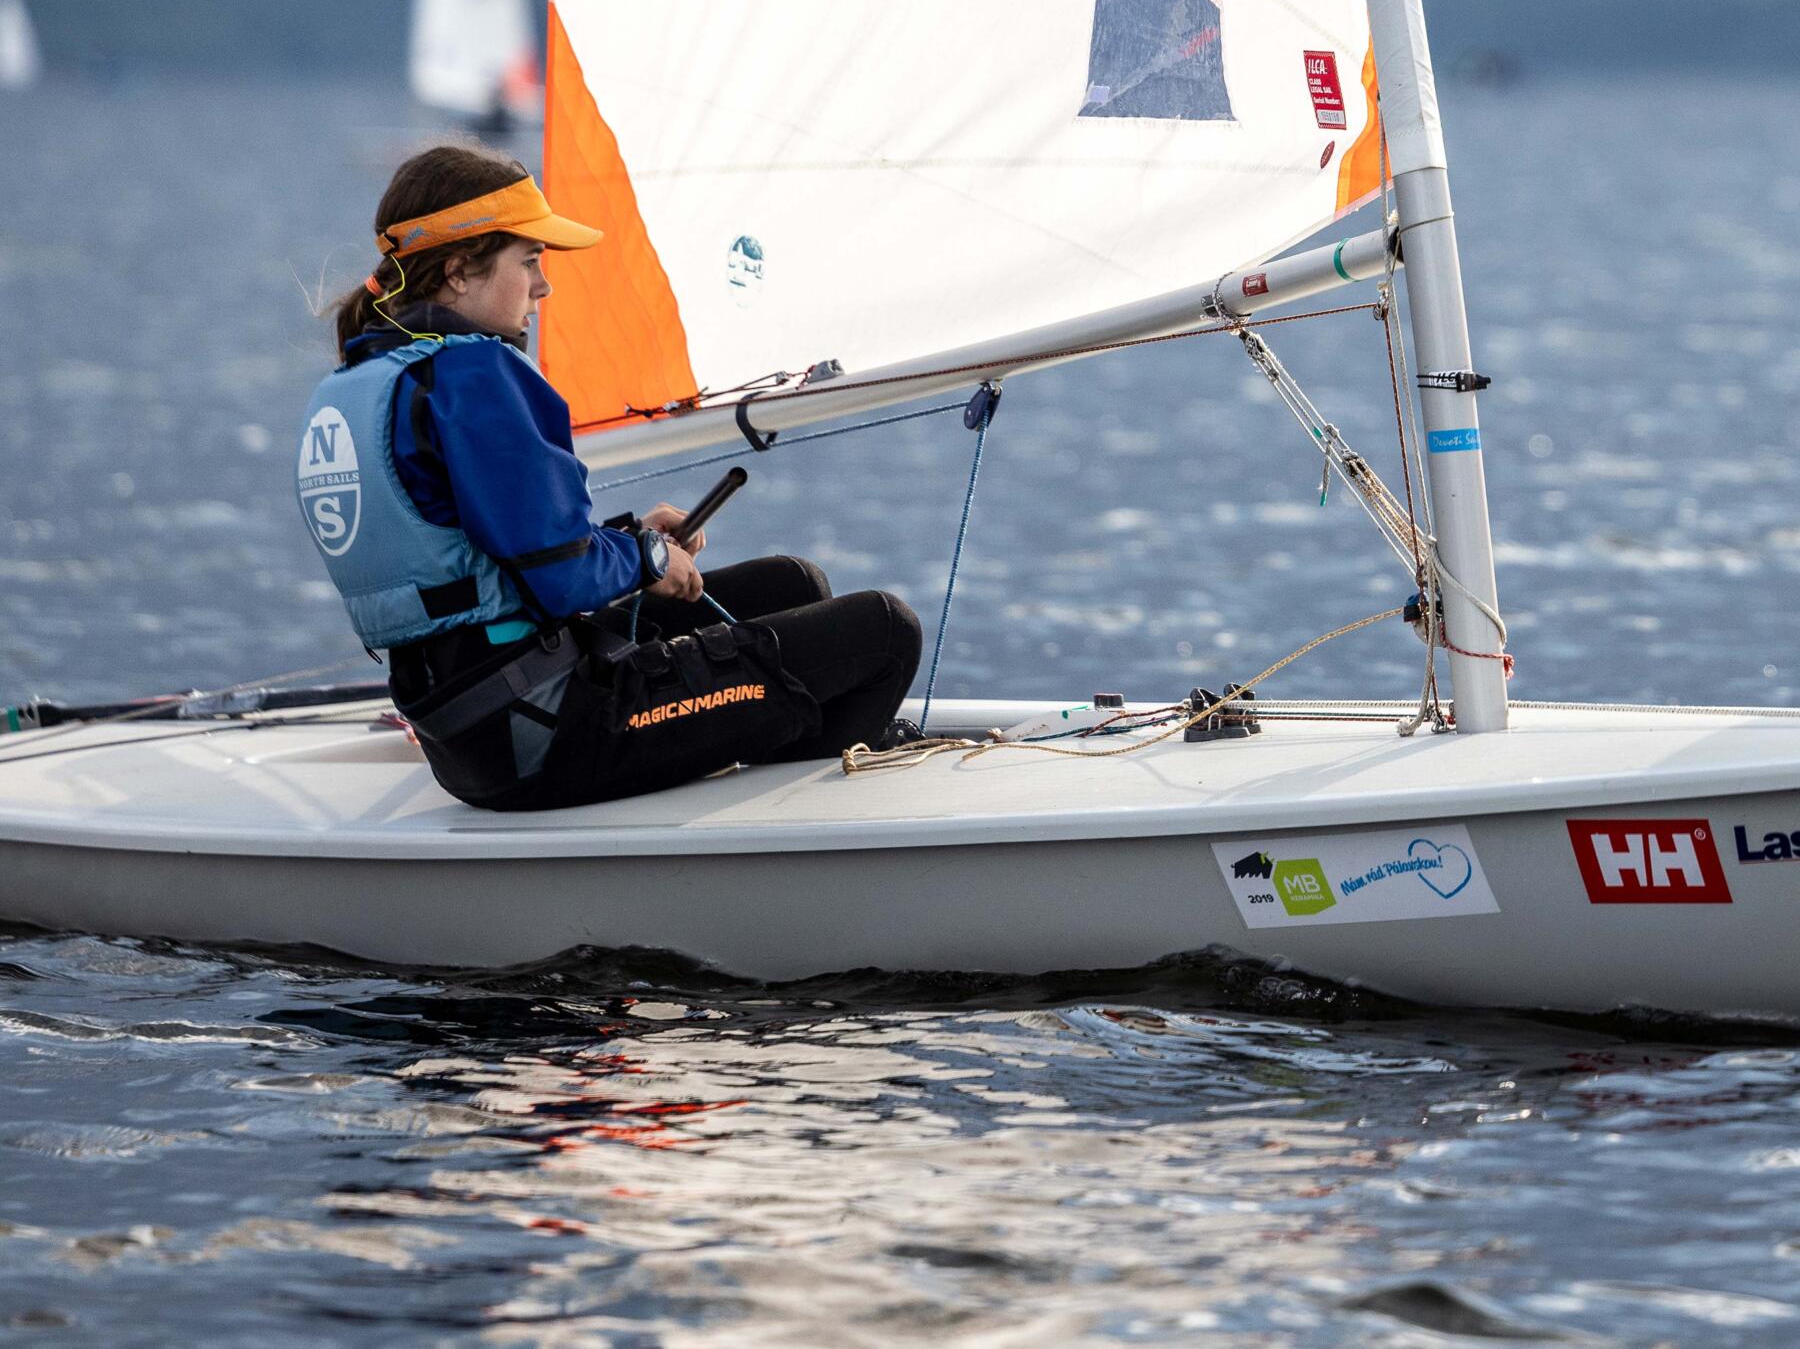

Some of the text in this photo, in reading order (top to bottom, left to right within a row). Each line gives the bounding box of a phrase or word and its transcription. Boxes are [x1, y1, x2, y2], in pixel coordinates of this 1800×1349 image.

[309, 423, 340, 466] N
[298, 471, 360, 491] NORTH SAILS
[313, 496, 347, 540] S
[693, 684, 765, 713] MARINE
[1282, 873, 1321, 895] MB
[1247, 893, 1275, 904] 2019
